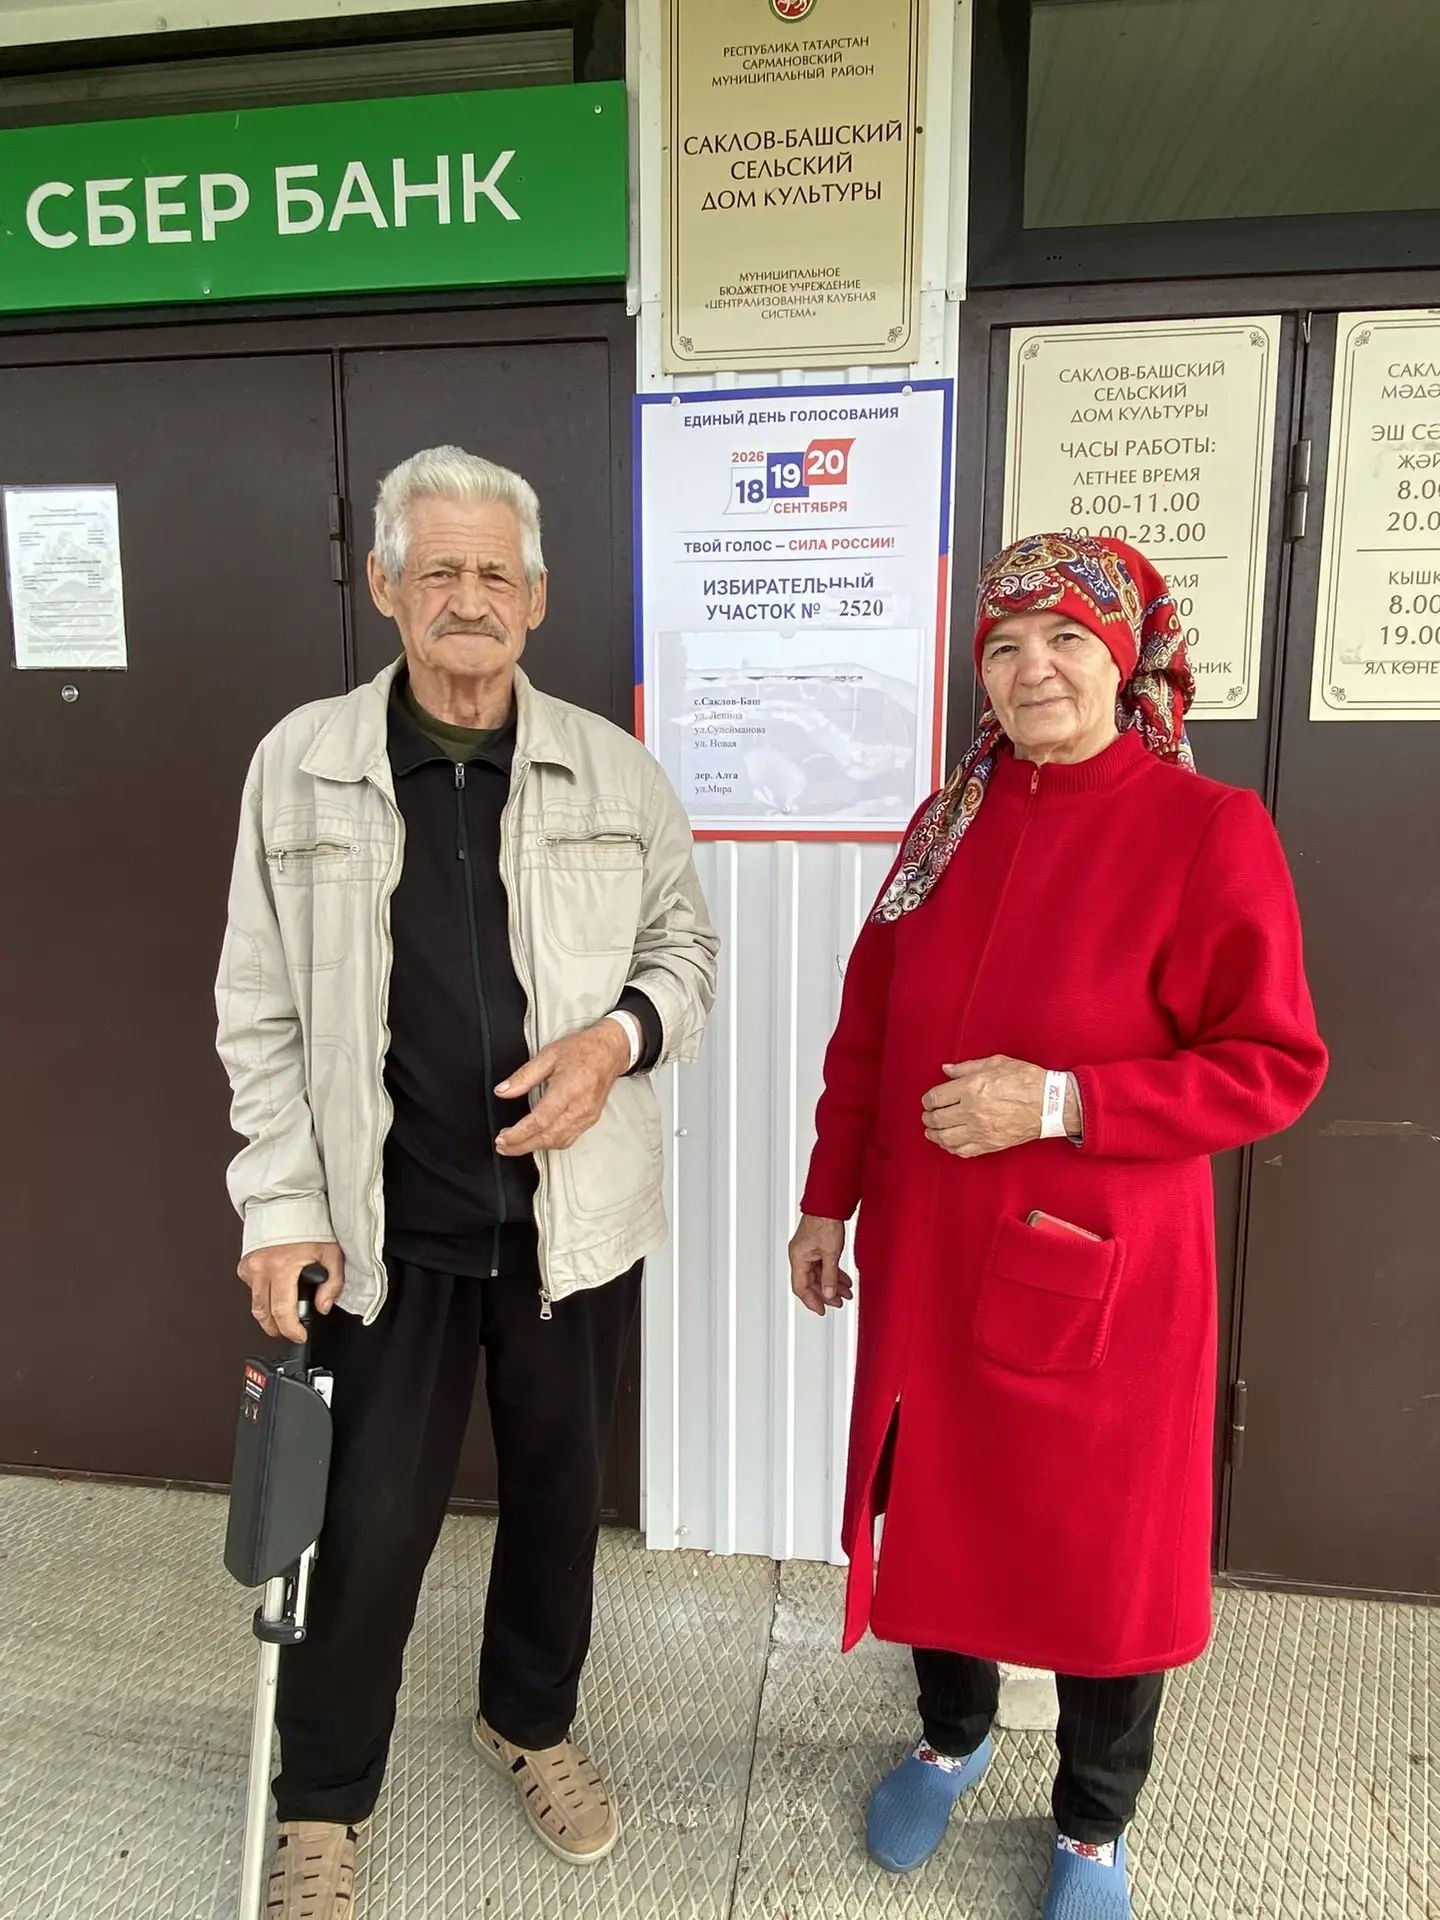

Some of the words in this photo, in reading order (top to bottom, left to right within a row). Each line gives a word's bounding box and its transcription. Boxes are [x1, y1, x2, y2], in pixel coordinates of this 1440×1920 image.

[723, 41, 800, 58] РЕСПУБЛИКА
[802, 36, 869, 51] ТАТАРСТАН
[742, 51, 843, 70] САРМАНОВСКИЙ
[711, 67, 825, 88] МУНИЦИПАЛЬНЫЙ
[831, 64, 874, 79] РАЙОН
[683, 119, 902, 156] САКЛОВ-БАШСКИЙ
[730, 151, 853, 180] СЕЛЬСКИЙ
[701, 190, 756, 211] ДОМ
[764, 181, 882, 207] КУЛЬТУРЫ
[739, 267, 841, 282] МУНИЦИПАЛЬНОЕ
[719, 283, 788, 296] БЮДЖЕТНОЕ
[790, 279, 861, 292] УЧРЕЖДЕНИЕ
[704, 295, 824, 310] «ЦЕНТРАЛИЗОВАННАЯ
[827, 291, 876, 304] КЛУБНАЯ
[761, 308, 817, 320] СИСТЕМА»
[1059, 360, 1225, 383] САКЛОВ-БАШСКИЙ
[1094, 382, 1187, 402] СЕЛЬСКИЙ
[684, 410, 744, 428] ЕДИНЫЙ
[747, 411, 786, 426] ДЕНЬ
[790, 407, 899, 422] ГОЛОСОВАНИЯ
[1070, 408, 1113, 423] ДОМ
[1118, 404, 1208, 421] КУЛЬТУРЫ
[1371, 424, 1404, 442] ЭШ
[731, 451, 764, 463] 2026
[1060, 440, 1118, 458] ЧАСЫ
[1126, 437, 1216, 457] РАБОТЫ:
[807, 449, 845, 475] 20
[770, 463, 801, 489] 19
[1073, 469, 1137, 486] ЛЕТНЕЕ
[1143, 467, 1200, 483] ВРЕМЯ
[735, 479, 764, 504] 18
[773, 501, 848, 514] СЕНТЯБРЯ
[1070, 491, 1200, 516] 8.00-11.00
[684, 539, 721, 553] ТВОЙ
[725, 540, 772, 552] ГОЛОС
[788, 539, 827, 551] СИЛА
[831, 537, 895, 550] РОССИИ!
[703, 572, 875, 596] ИЗБИРАТЕЛЬНЫЙ
[706, 603, 796, 621] УЧАСТОК
[801, 602, 821, 619] №
[839, 599, 884, 617] 2520
[1364, 661, 1386, 675] ЯЛ
[710, 739, 737, 748] Новая
[715, 771, 739, 780] Алга
